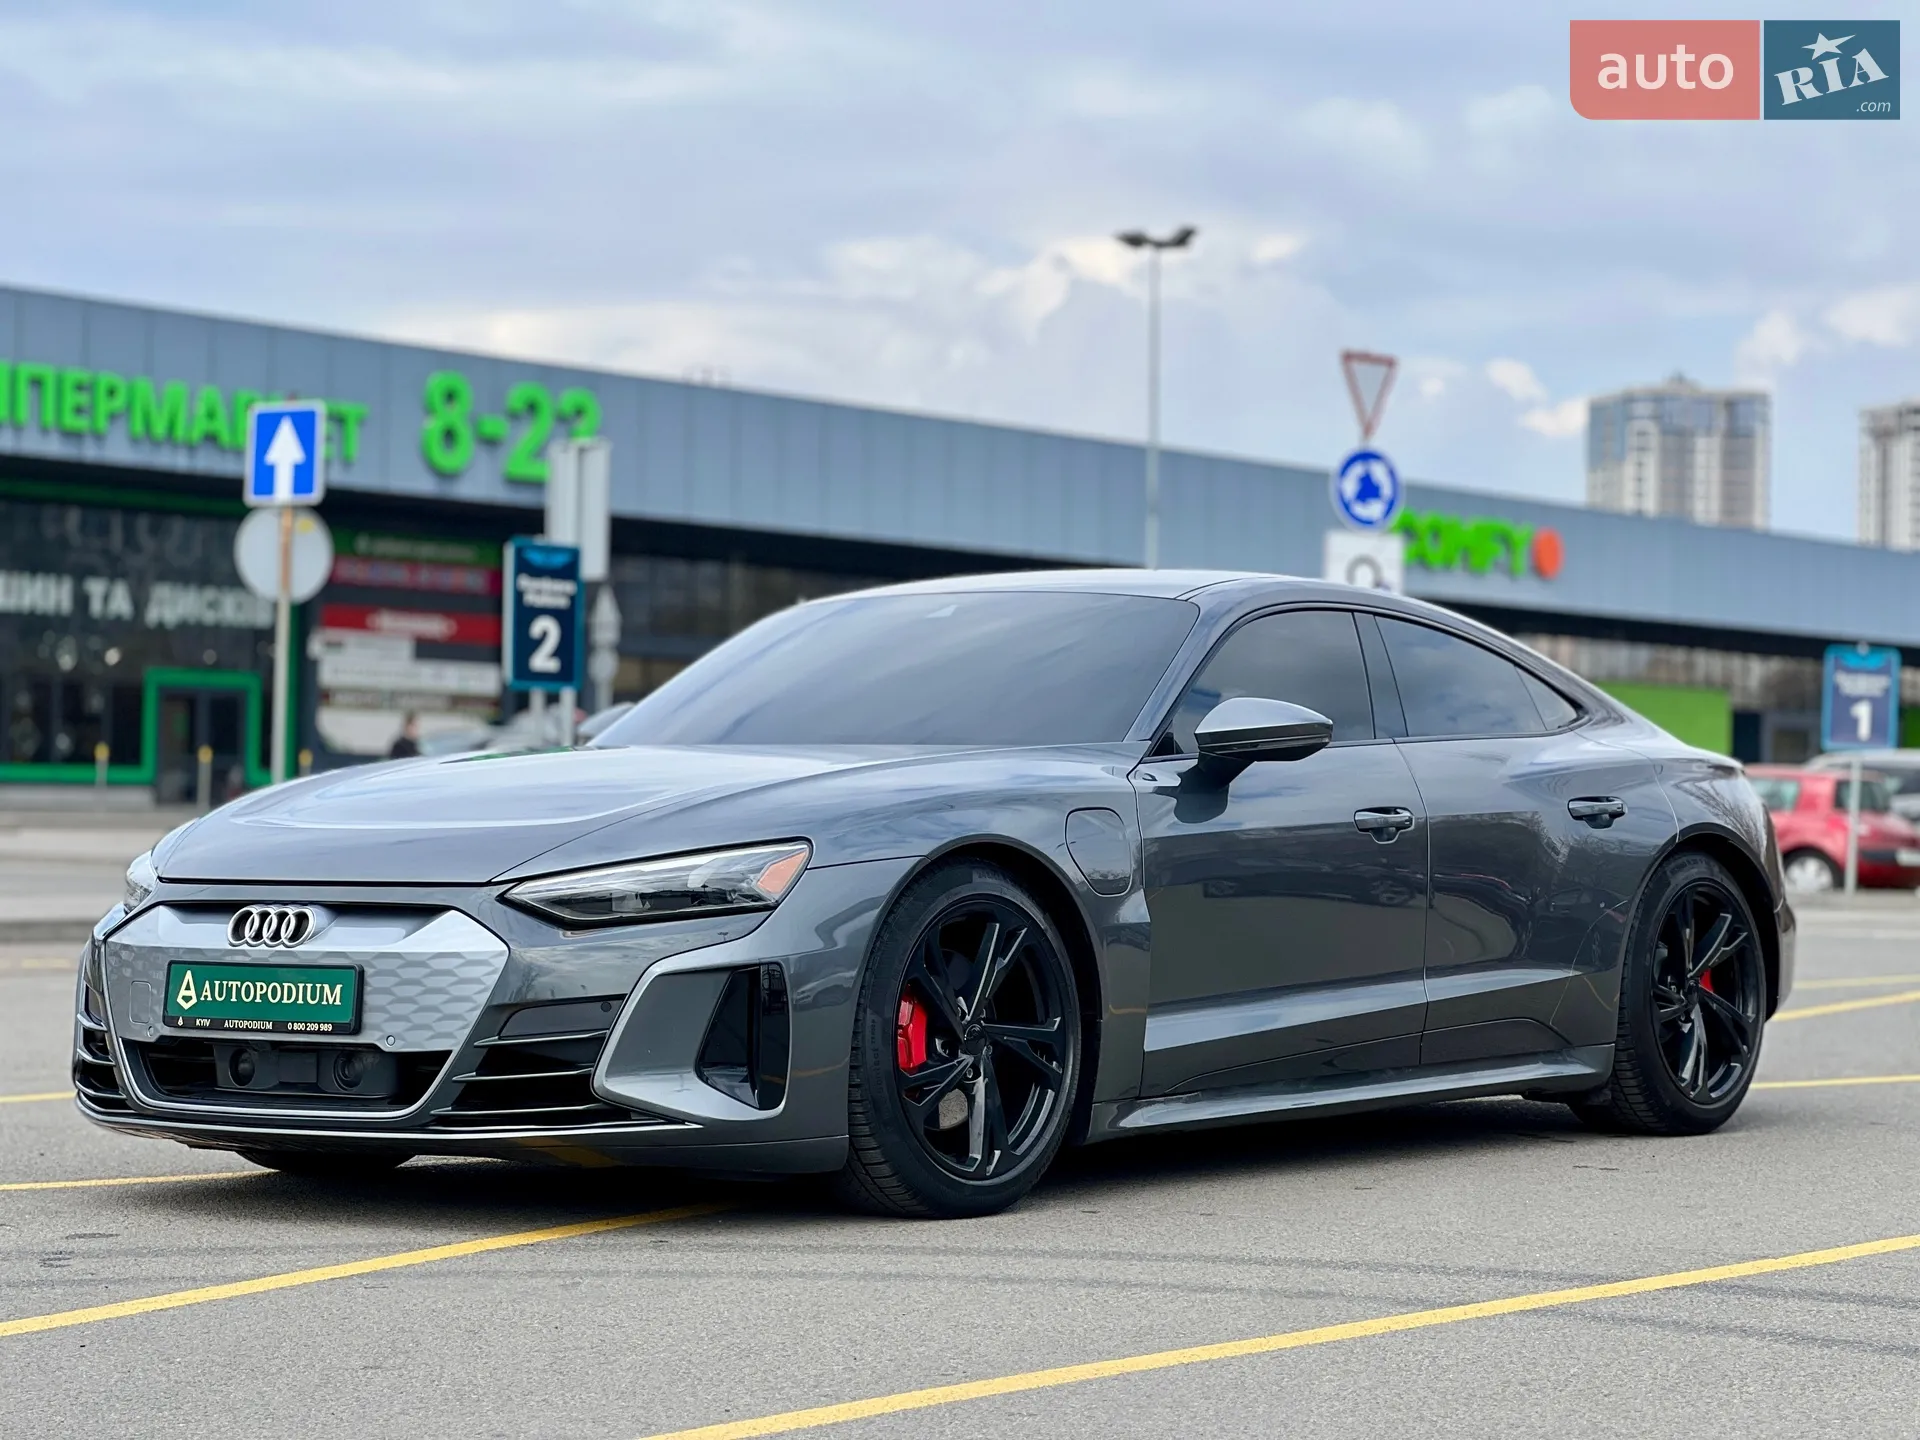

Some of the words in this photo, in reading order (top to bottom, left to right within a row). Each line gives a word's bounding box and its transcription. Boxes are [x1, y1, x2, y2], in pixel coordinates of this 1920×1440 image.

[83, 575, 134, 621] ТА
[529, 614, 562, 673] 2
[1850, 699, 1873, 741] 1
[200, 980, 343, 1006] AUTOPODIUM
[195, 1018, 211, 1027] KYIV
[223, 1019, 273, 1030] AUTOPODIUM
